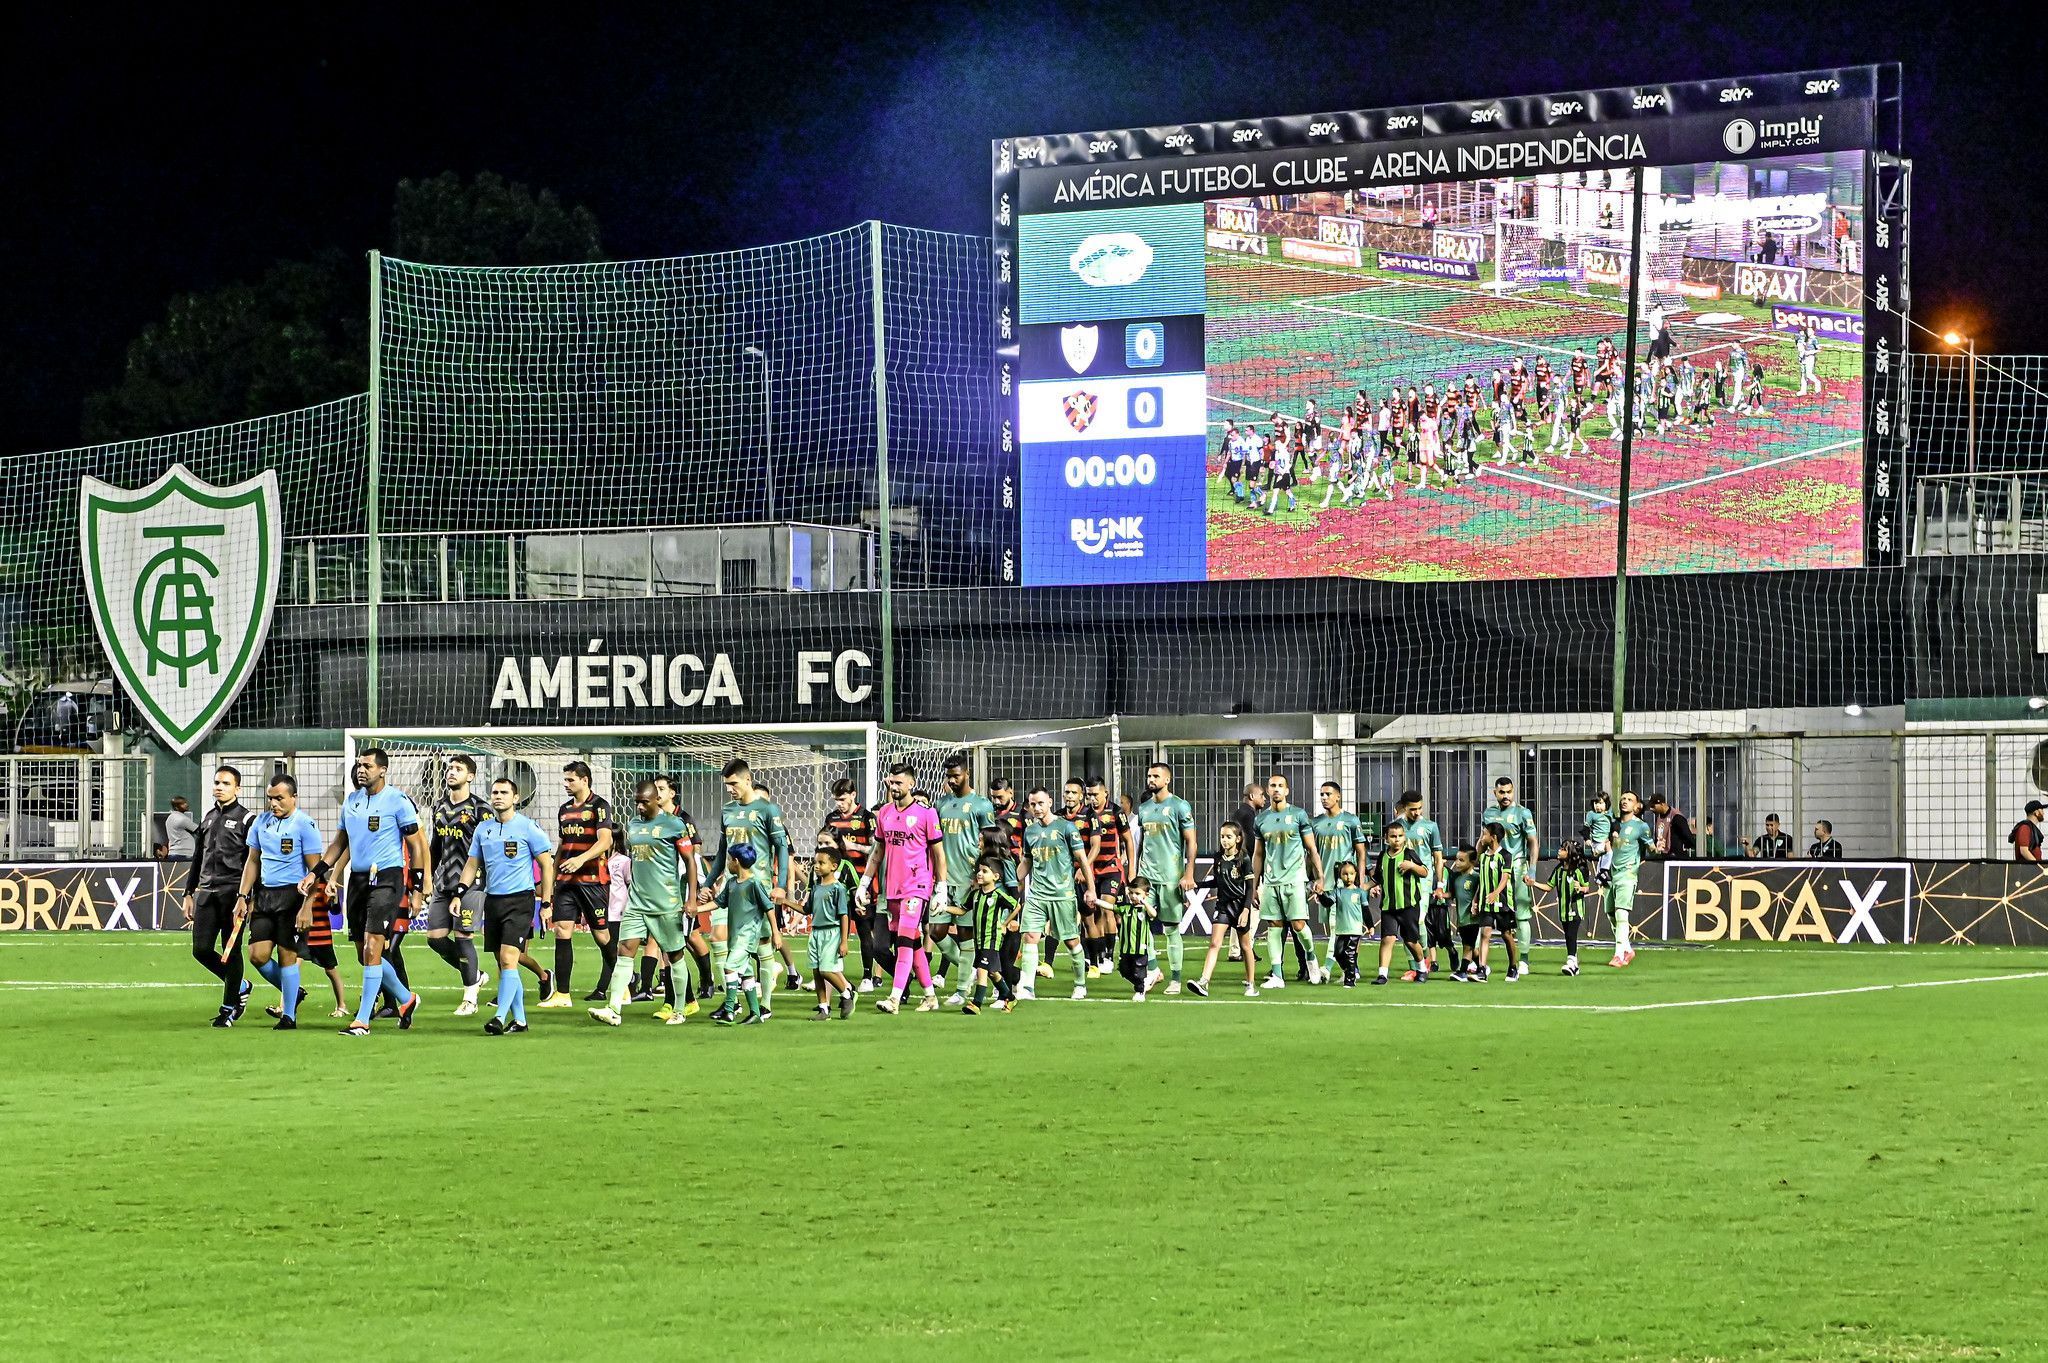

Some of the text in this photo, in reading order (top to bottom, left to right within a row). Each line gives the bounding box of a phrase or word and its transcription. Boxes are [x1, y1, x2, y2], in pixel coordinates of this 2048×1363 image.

[1632, 94, 1666, 110] SKY+
[1719, 87, 1753, 102] SKY+
[1804, 80, 1840, 95] SKY+
[1387, 115, 1418, 130] SKY+
[1470, 108, 1502, 124] SKY+
[1550, 101, 1583, 116] SKY+
[1164, 134, 1194, 148] SKY+
[1232, 129, 1263, 143] SKY+
[1308, 122, 1339, 137] SKY+
[1760, 116, 1821, 139] imply
[1761, 137, 1820, 149] IMPLY.COM
[1089, 140, 1118, 154] SKY+
[1054, 169, 1155, 204] AMÉRICA
[1160, 164, 1267, 195] FUTEBOL
[1272, 157, 1348, 187] CLUBE
[1369, 149, 1451, 180] ARENA
[1457, 131, 1648, 173] INDEPENDÊNCIA
[1000, 193, 1010, 226] SKY+
[1437, 235, 1479, 262] BRAX
[1001, 250, 1011, 283] SKY+
[1741, 268, 1799, 301] BRAX
[1876, 274, 1889, 312] SKY+
[1001, 306, 1011, 339] SKY+
[1135, 329, 1157, 360] 0
[1876, 336, 1889, 374] SKY+
[1001, 363, 1011, 396] SKY+
[1134, 391, 1156, 424] 0
[1876, 398, 1889, 436] SKY+
[1002, 420, 1012, 453] SKY+
[1065, 453, 1156, 488] 00:00
[1877, 460, 1890, 498] SKY+
[1003, 476, 1013, 509] SKY+
[1877, 516, 1890, 553] SKY+
[1003, 548, 1013, 582] SKY+
[490, 638, 873, 709] AMÉRICA FC
[0, 877, 141, 930] BRAX
[1685, 879, 1888, 945] BRAX
